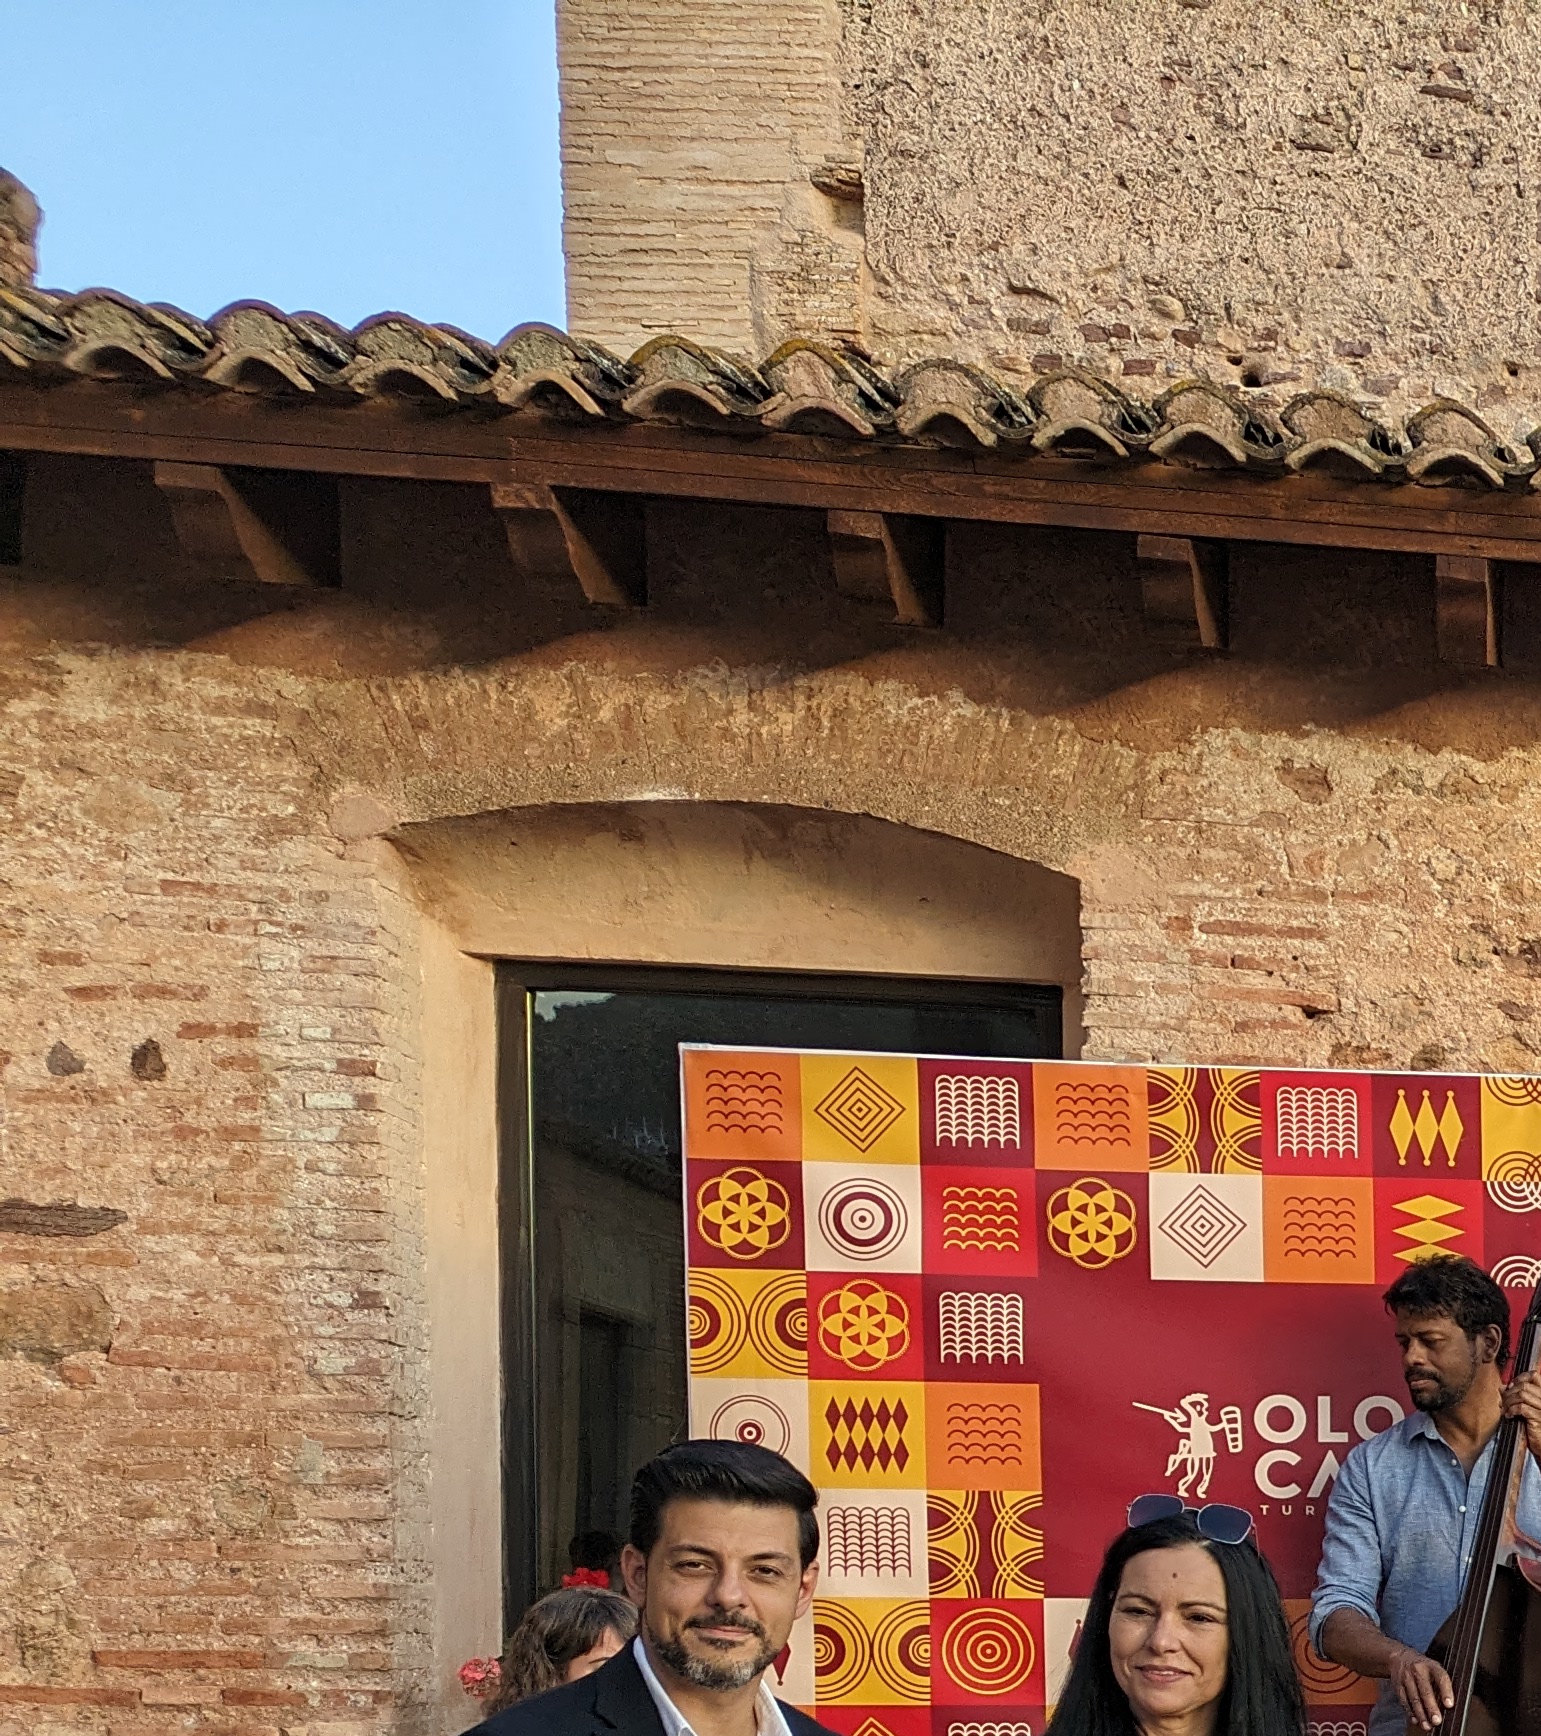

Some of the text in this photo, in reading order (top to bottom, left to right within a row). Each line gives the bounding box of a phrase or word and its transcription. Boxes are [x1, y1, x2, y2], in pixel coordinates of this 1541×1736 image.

[1253, 1393, 1406, 1444] OLO
[1254, 1449, 1341, 1499] CA
[1259, 1504, 1316, 1516] TUR
